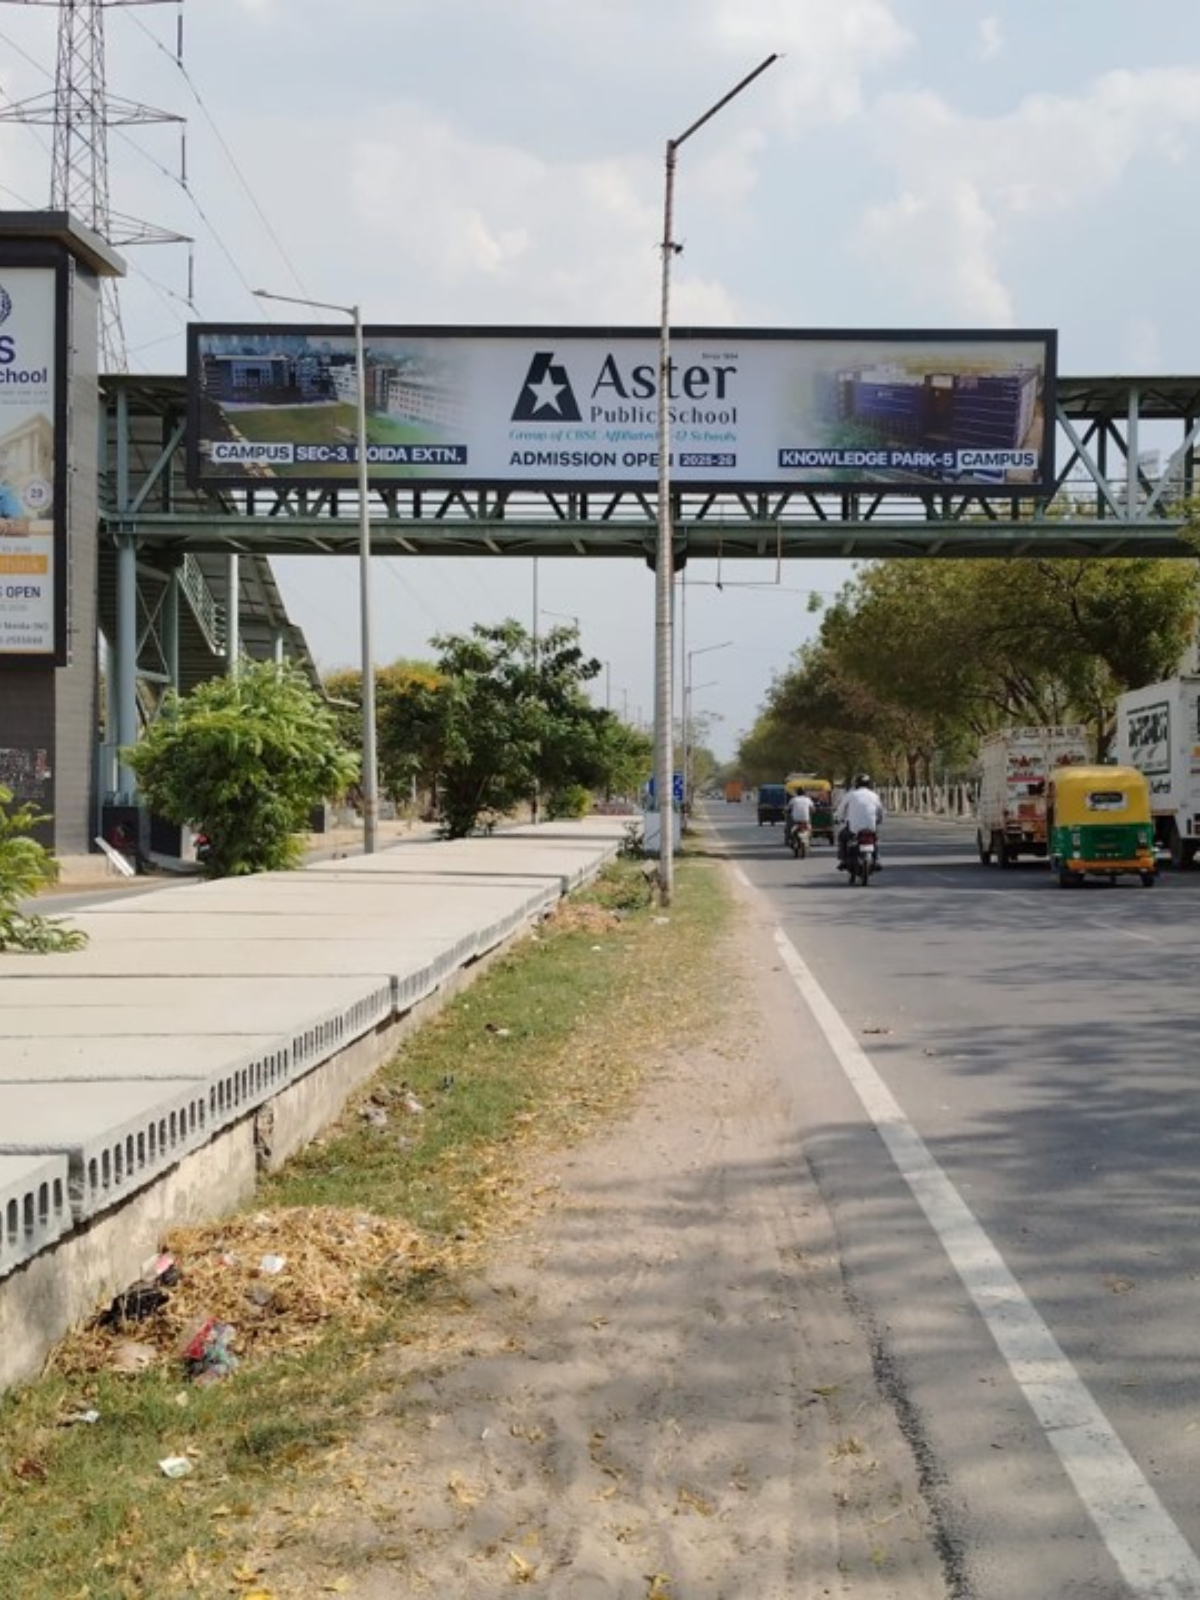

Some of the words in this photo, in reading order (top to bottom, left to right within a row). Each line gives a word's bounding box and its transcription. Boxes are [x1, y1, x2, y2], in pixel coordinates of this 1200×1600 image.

[591, 405, 657, 424] Public
[668, 405, 737, 425] School
[215, 445, 291, 461] CAMPUS
[411, 447, 462, 462] EXTN.
[509, 451, 616, 468] ADMISSION
[781, 450, 887, 466] KNOWLEDGE
[891, 451, 954, 467] PARK-5
[961, 451, 1035, 467] CAMPUS
[6, 586, 42, 599] OPEN
